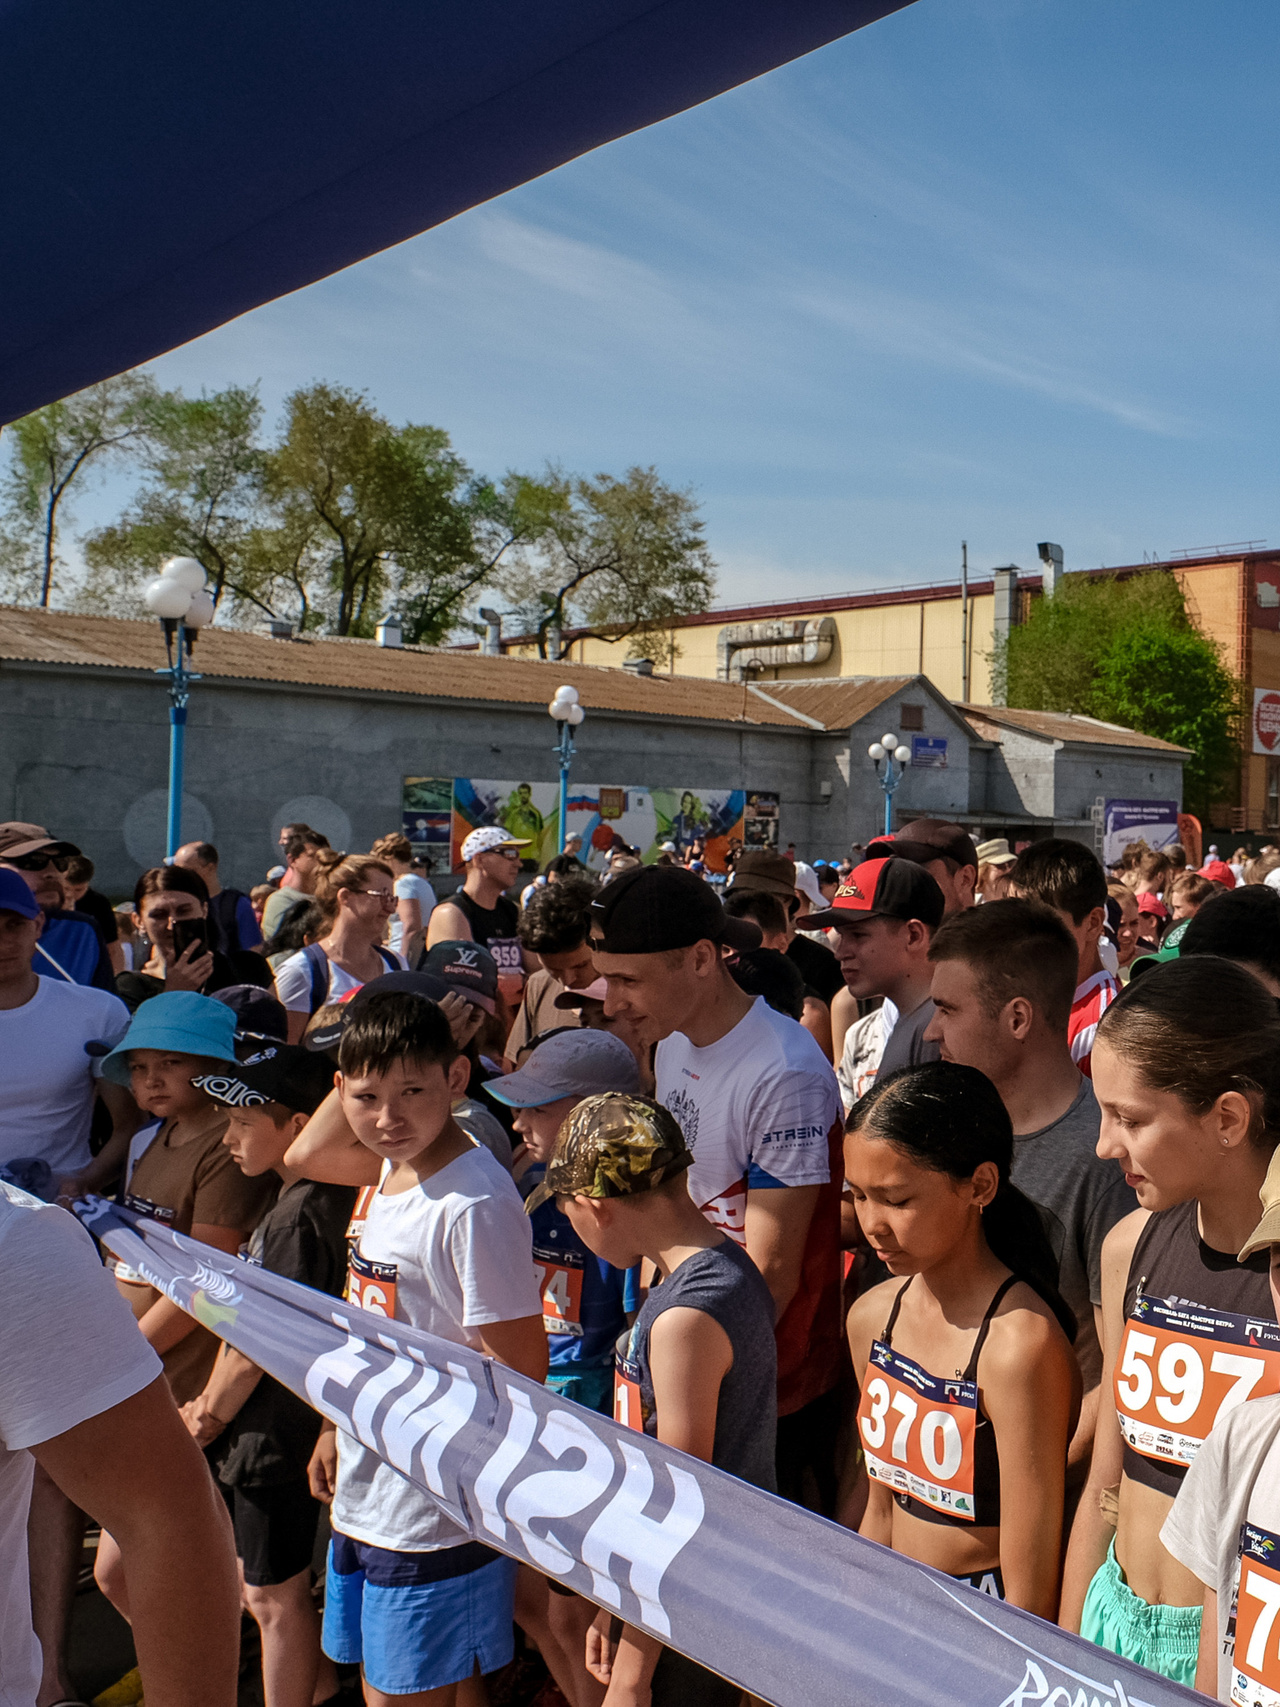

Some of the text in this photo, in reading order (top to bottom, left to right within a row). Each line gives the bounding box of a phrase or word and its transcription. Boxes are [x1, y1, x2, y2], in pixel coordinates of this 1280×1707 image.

[444, 965, 483, 978] Supreme
[861, 1378, 962, 1480] 370
[1117, 1329, 1266, 1432] 597
